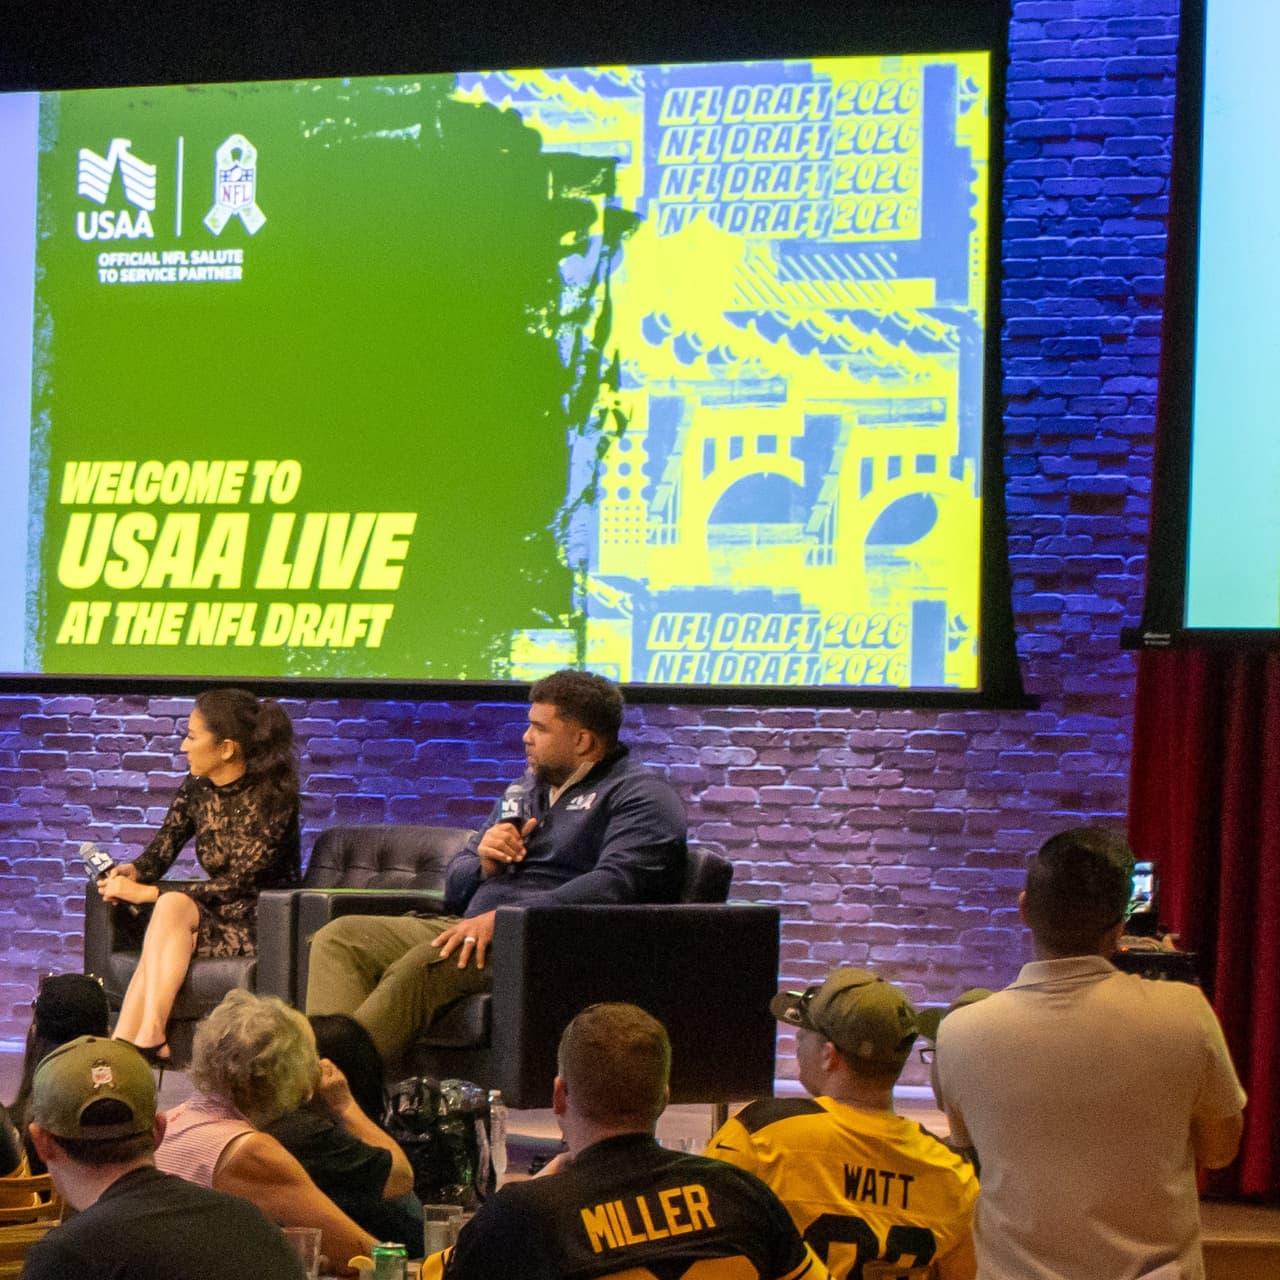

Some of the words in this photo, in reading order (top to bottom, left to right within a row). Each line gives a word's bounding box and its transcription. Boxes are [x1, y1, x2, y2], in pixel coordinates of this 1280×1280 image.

[659, 87, 722, 126] NFL
[722, 83, 831, 123] DRAFT
[658, 127, 721, 164] NFL
[722, 123, 831, 162] DRAFT
[222, 184, 250, 205] NFL
[659, 165, 721, 203] NFL
[722, 162, 831, 200] DRAFT
[77, 210, 154, 241] USAA
[98, 252, 161, 267] OFFICIAL
[162, 251, 189, 266] NFL
[190, 249, 244, 265] SALUTE
[98, 268, 118, 283] TO
[120, 267, 176, 283] SERVICE
[178, 266, 243, 281] PARTNER
[60, 460, 249, 505] WELCOME
[250, 459, 302, 505] TO
[57, 511, 250, 590] USAA
[255, 512, 418, 590] LIVE
[56, 601, 111, 645] AT
[112, 601, 187, 646] THE
[186, 602, 258, 646] NFL
[260, 603, 394, 648] DRAFT
[647, 612, 711, 651] NFL
[711, 612, 820, 652] DRAFT
[844, 1163, 915, 1210] WATT
[580, 1184, 717, 1254] MILLER
